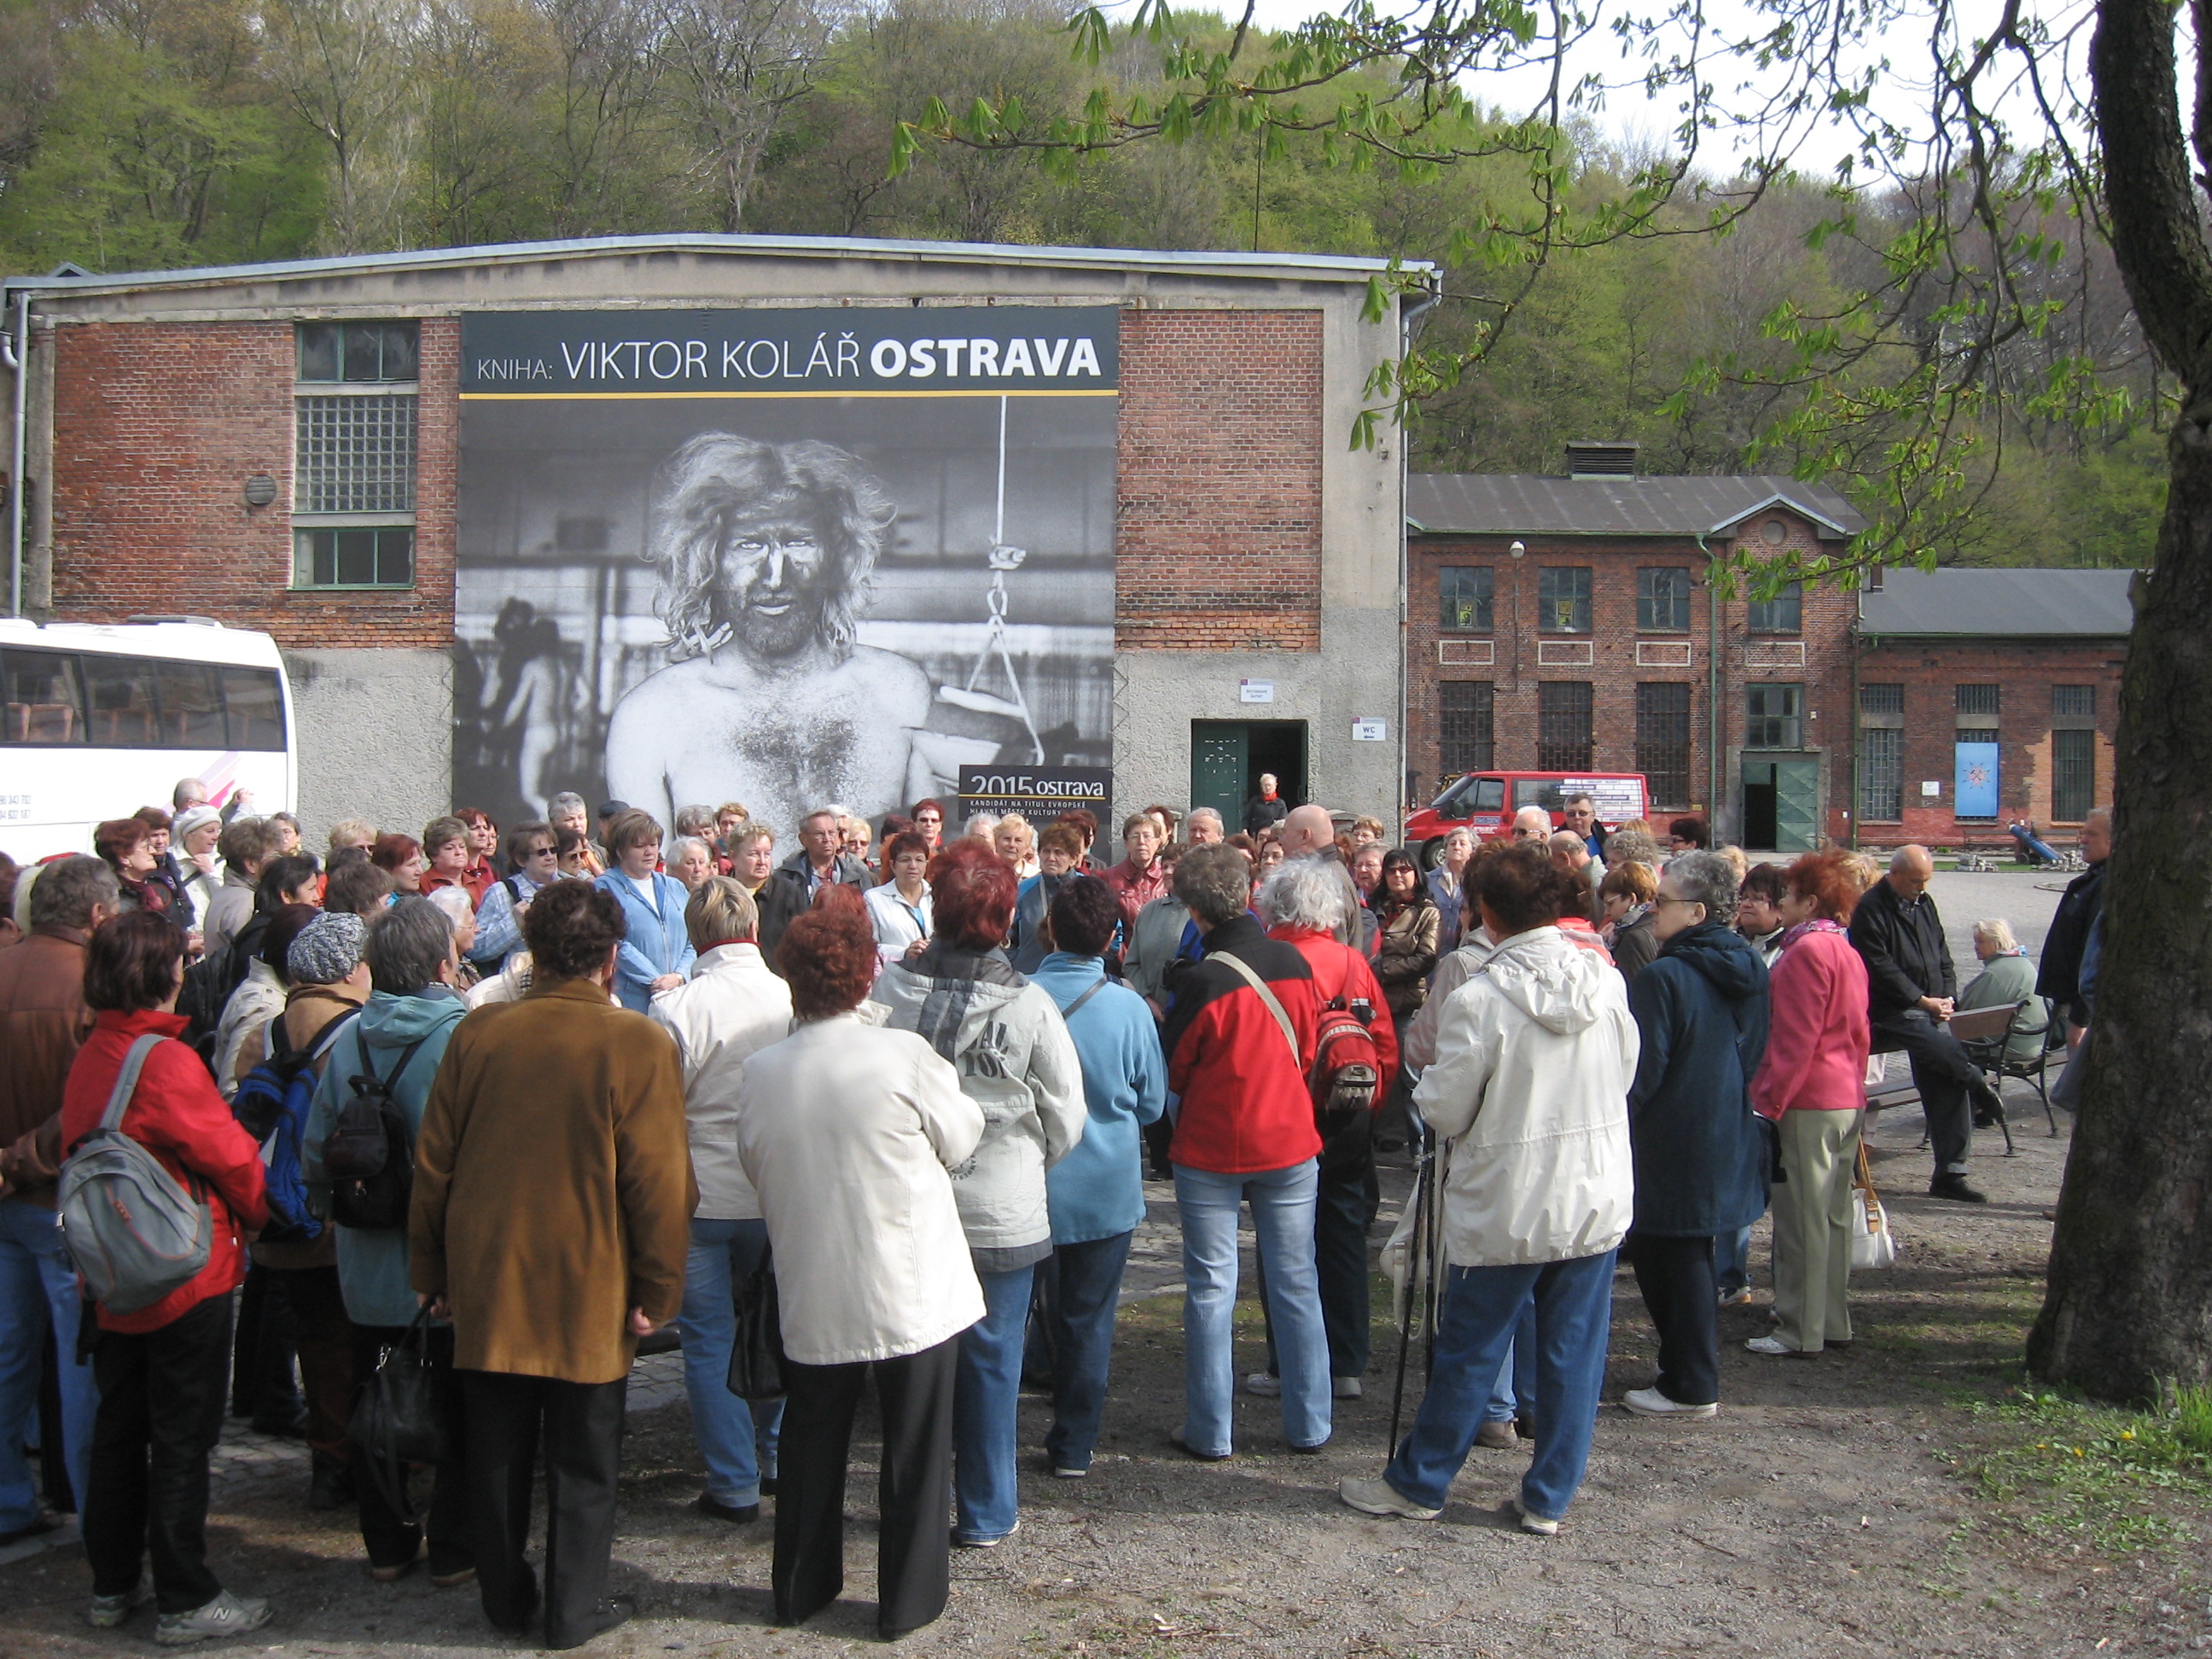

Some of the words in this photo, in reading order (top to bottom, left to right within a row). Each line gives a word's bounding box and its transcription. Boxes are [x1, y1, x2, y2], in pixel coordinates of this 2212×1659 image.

[477, 358, 553, 380] KNIHA:
[561, 341, 708, 380] VIKTOR
[722, 331, 860, 378] KOLÁŘ
[870, 338, 1102, 378] OSTRAVA
[970, 775, 1034, 795] 2015
[1036, 780, 1104, 796] ostrava
[969, 799, 1008, 807] KANDIDÁT
[1048, 800, 1086, 809] EVROPSKÉ
